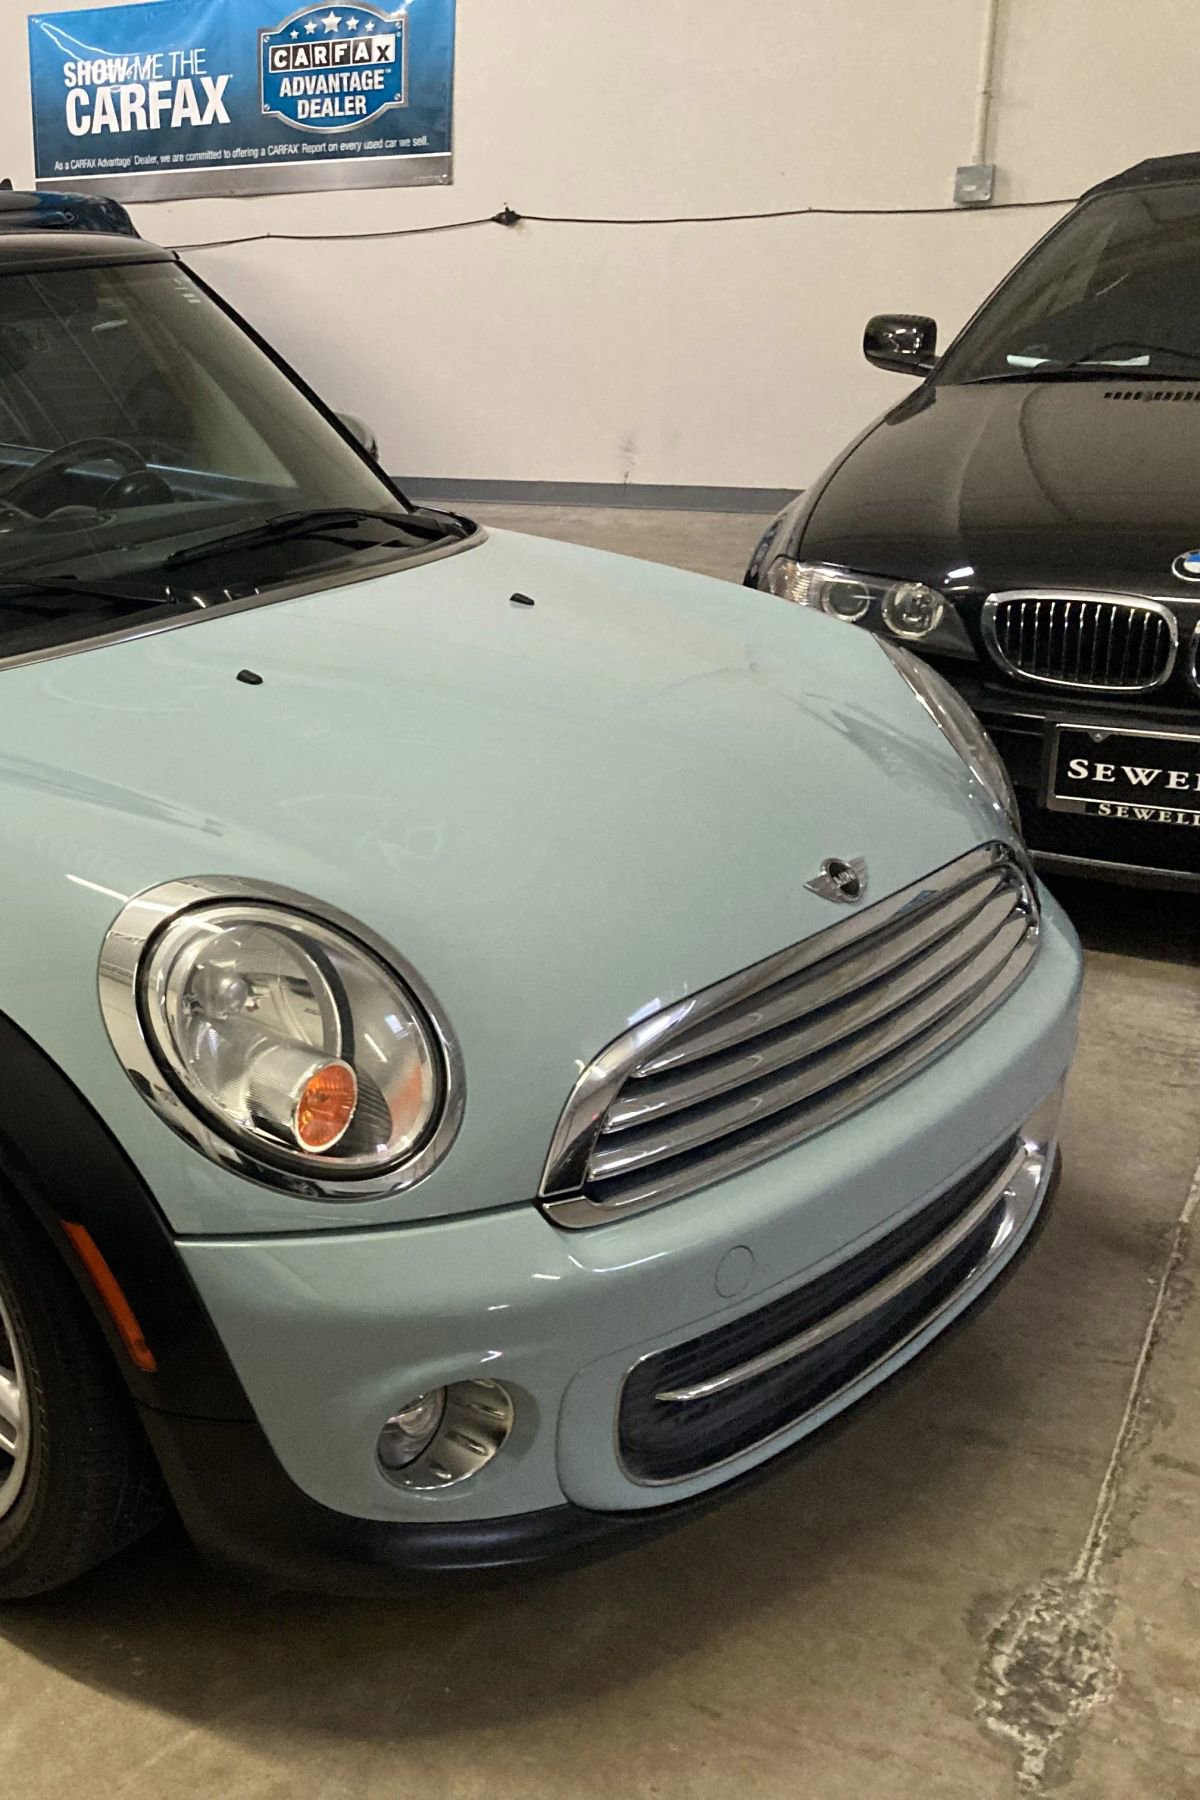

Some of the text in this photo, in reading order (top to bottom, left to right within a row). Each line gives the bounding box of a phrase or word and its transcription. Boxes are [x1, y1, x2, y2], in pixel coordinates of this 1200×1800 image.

[63, 48, 207, 88] SHOW ME THE
[273, 40, 391, 68] CARFAX
[65, 75, 231, 137] CARFAX
[297, 95, 367, 119] DEALER
[54, 161, 64, 171] As
[70, 158, 96, 169] CARFAX
[134, 154, 159, 166] Dealer,
[160, 155, 171, 163] we
[172, 154, 184, 162] are
[186, 149, 222, 161] committed
[223, 150, 231, 159] to
[232, 147, 259, 160] offering
[267, 144, 299, 156] CARFAX
[302, 142, 326, 155] Report
[328, 143, 338, 152] on
[340, 142, 361, 153] every
[364, 138, 383, 149] used
[385, 140, 397, 148] car
[399, 139, 410, 147] we
[412, 135, 430, 146] sell.
